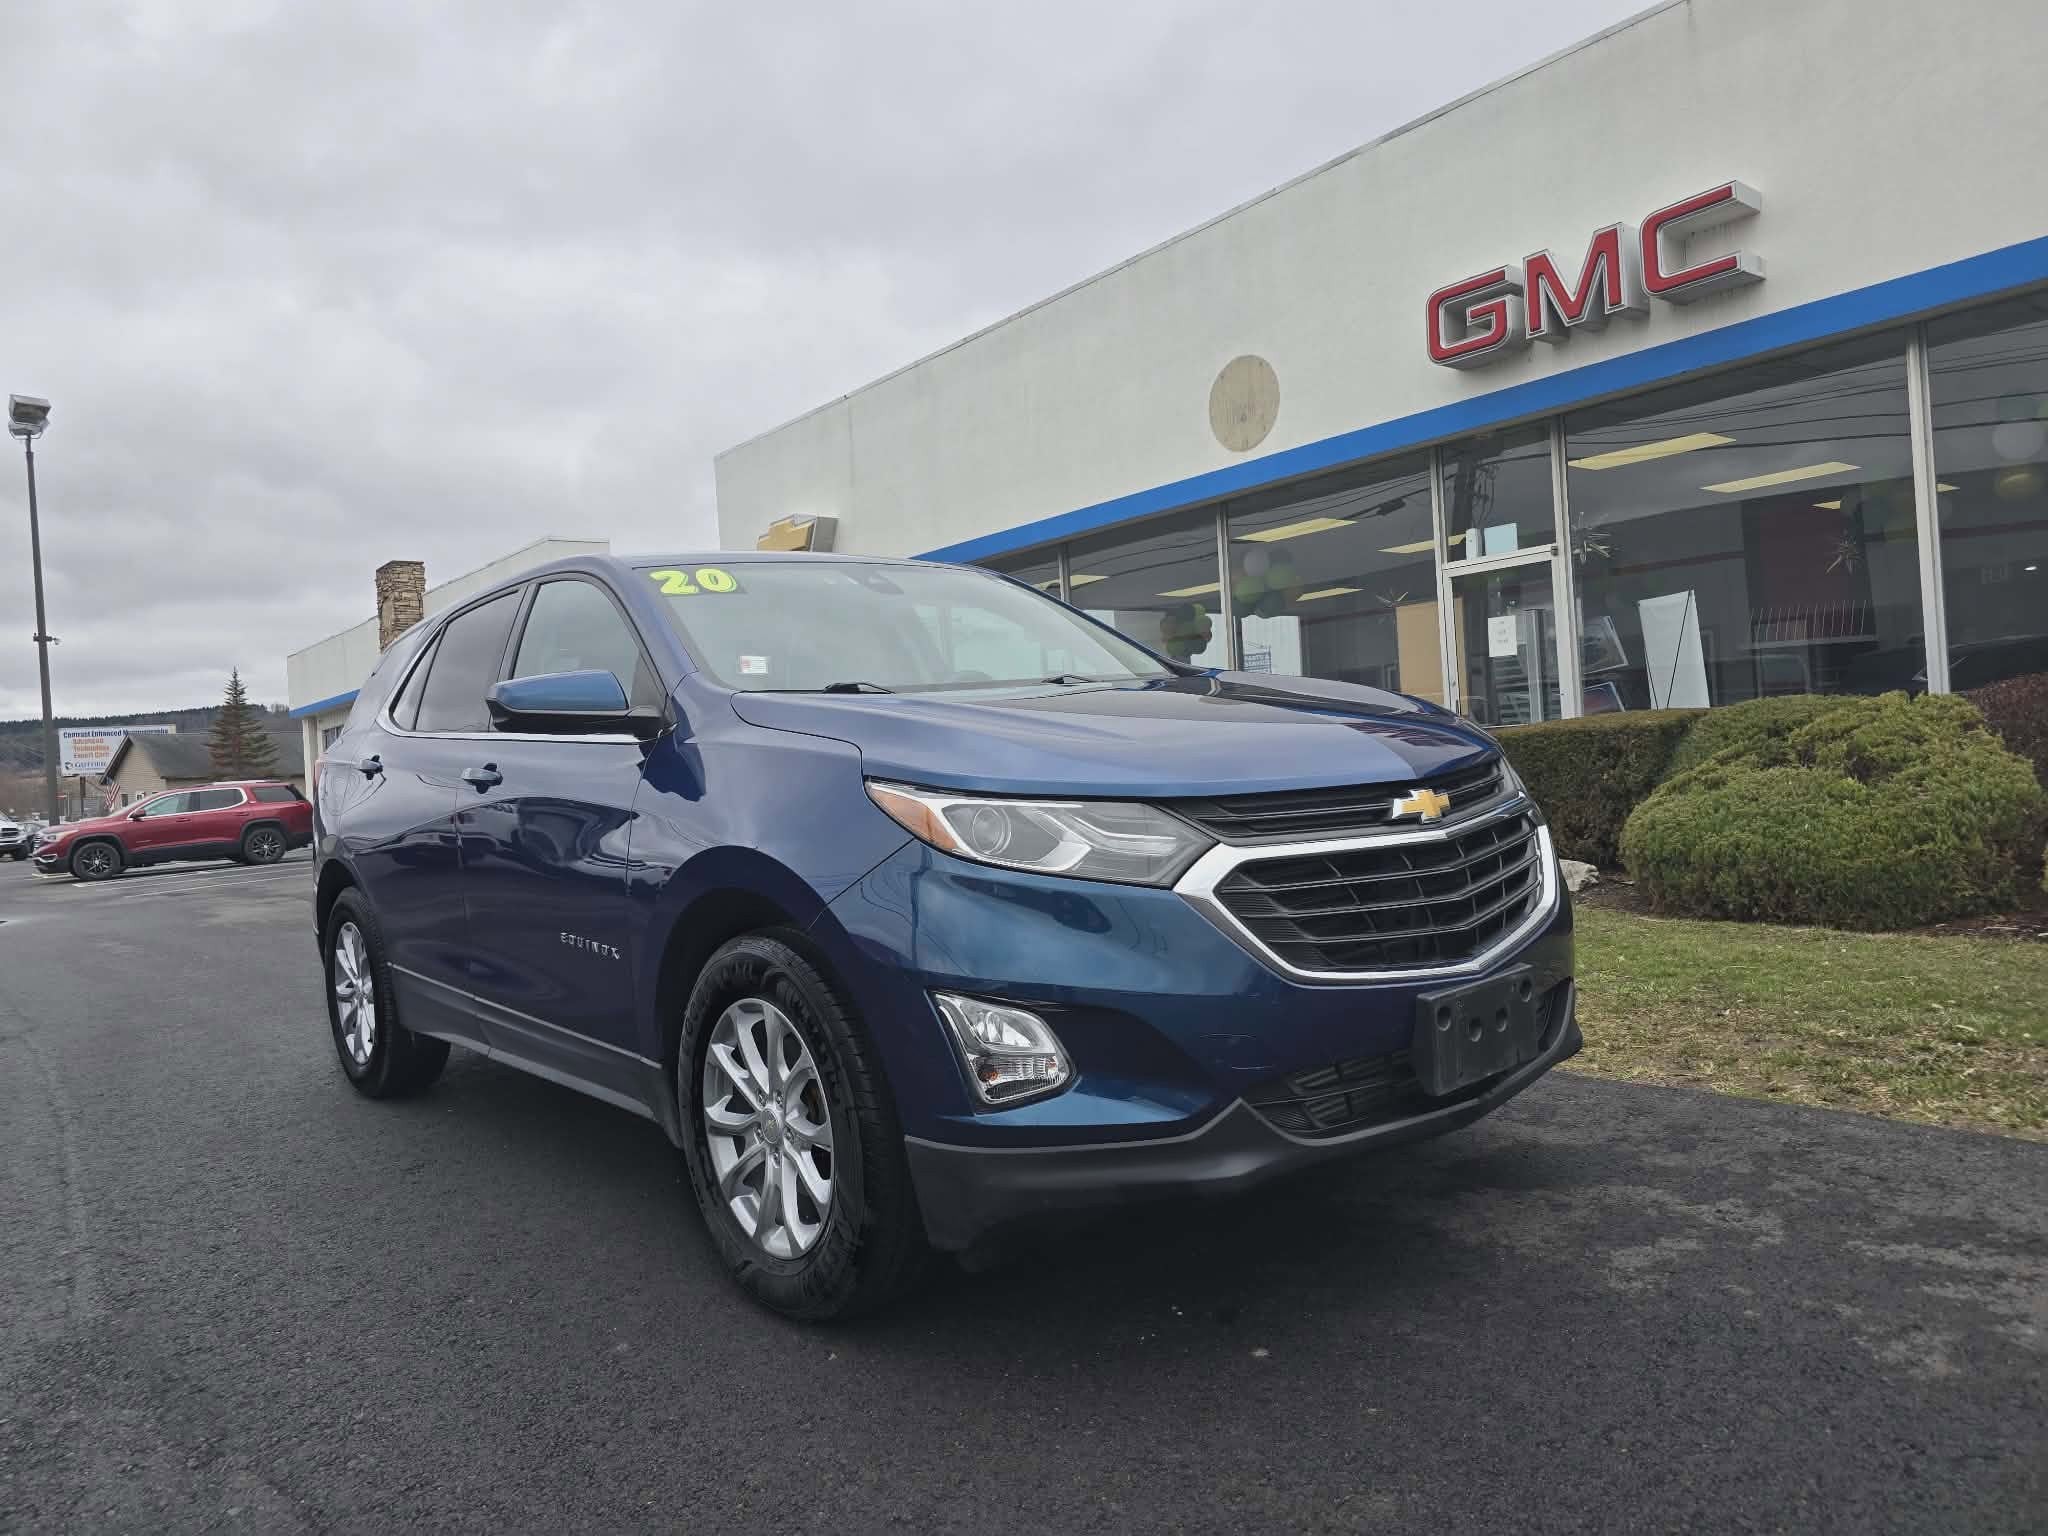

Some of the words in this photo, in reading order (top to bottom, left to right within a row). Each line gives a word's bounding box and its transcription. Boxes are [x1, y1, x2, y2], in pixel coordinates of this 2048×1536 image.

[1426, 180, 1764, 368] GMC
[649, 568, 737, 595] 20
[560, 932, 620, 960] EQUINOX
